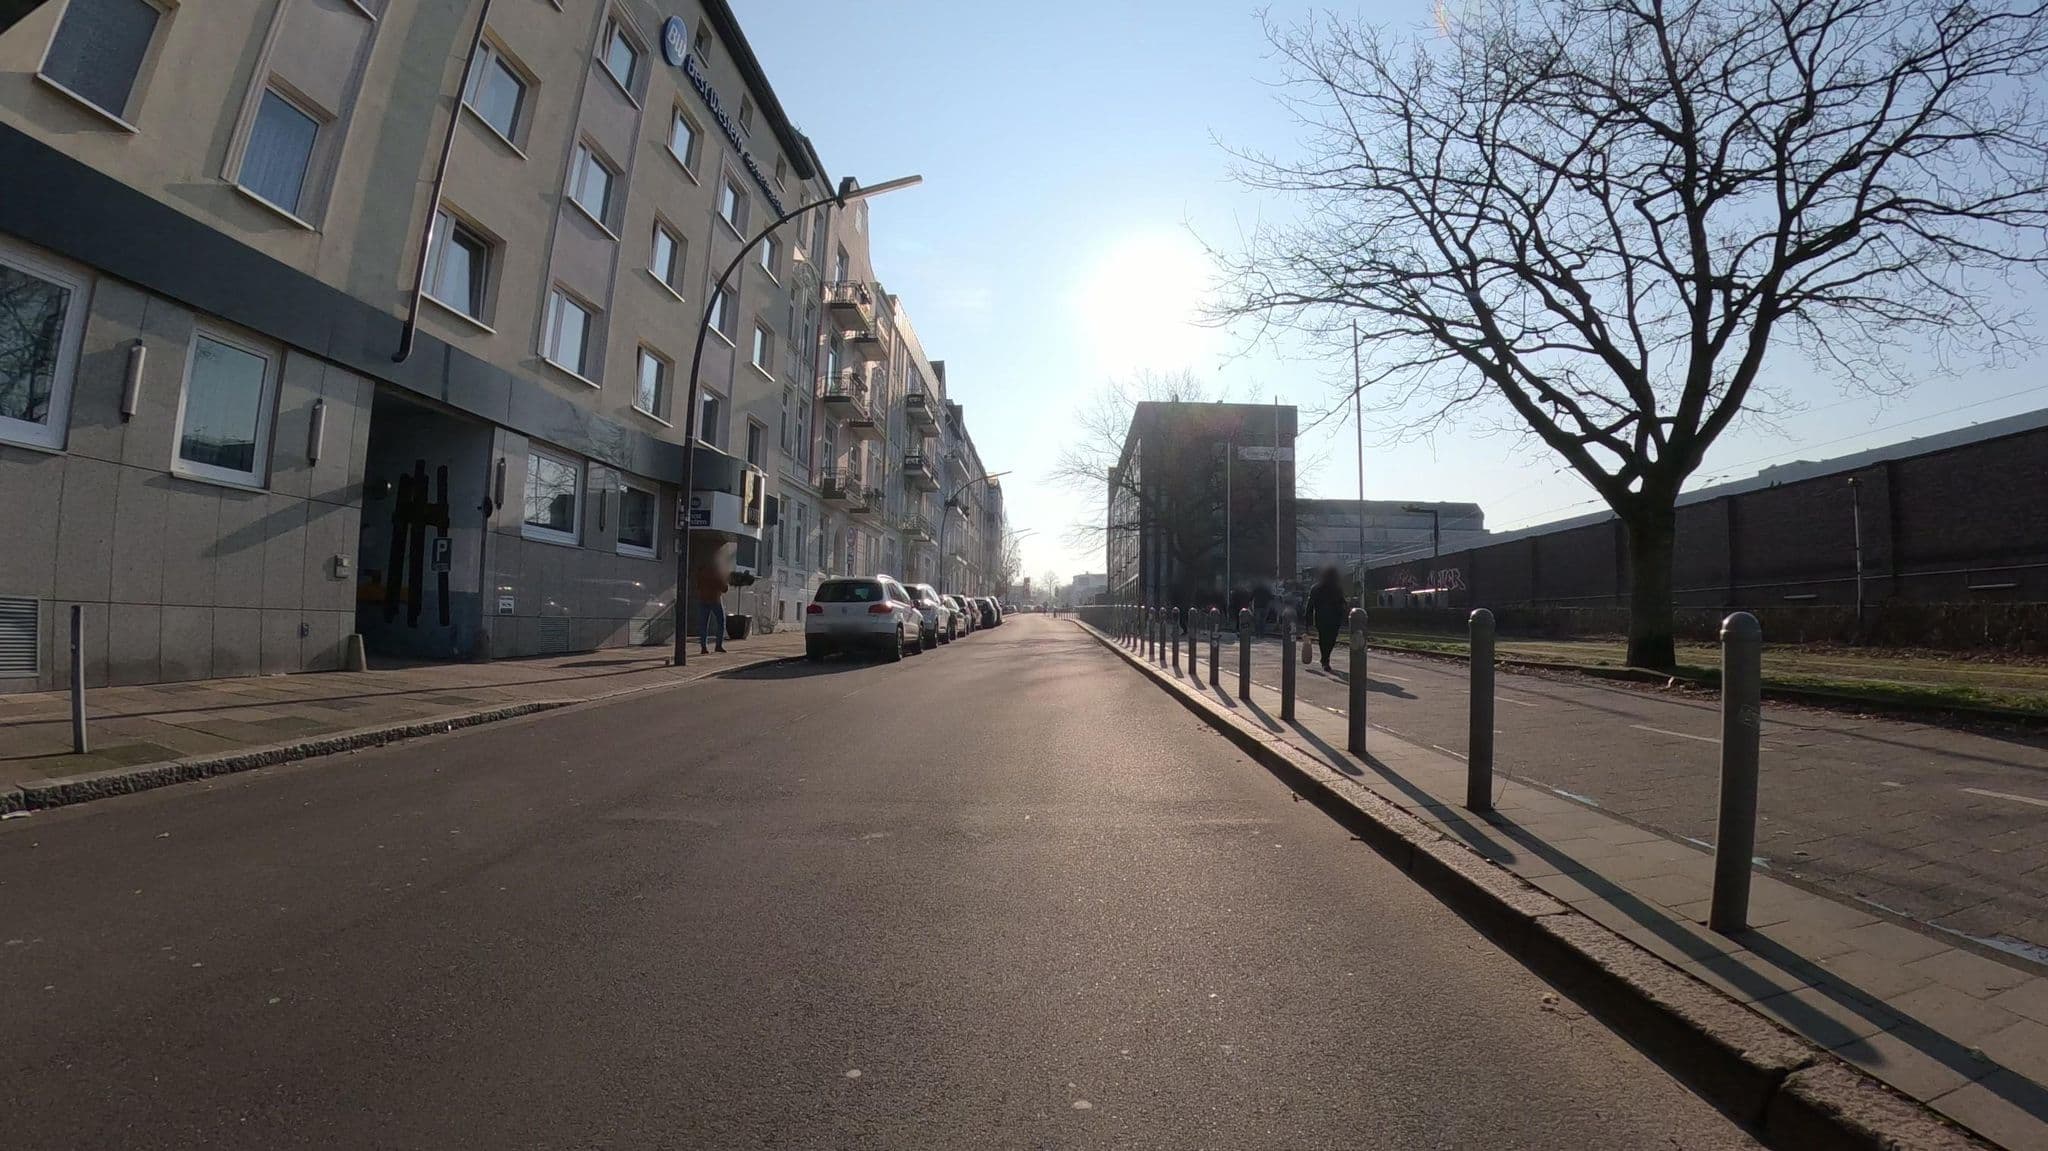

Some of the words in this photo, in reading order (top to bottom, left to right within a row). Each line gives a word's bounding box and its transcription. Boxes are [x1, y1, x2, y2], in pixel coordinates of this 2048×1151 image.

[668, 23, 687, 58] BW
[687, 55, 709, 100] Best
[711, 88, 742, 154] Western
[437, 540, 447, 561] P
